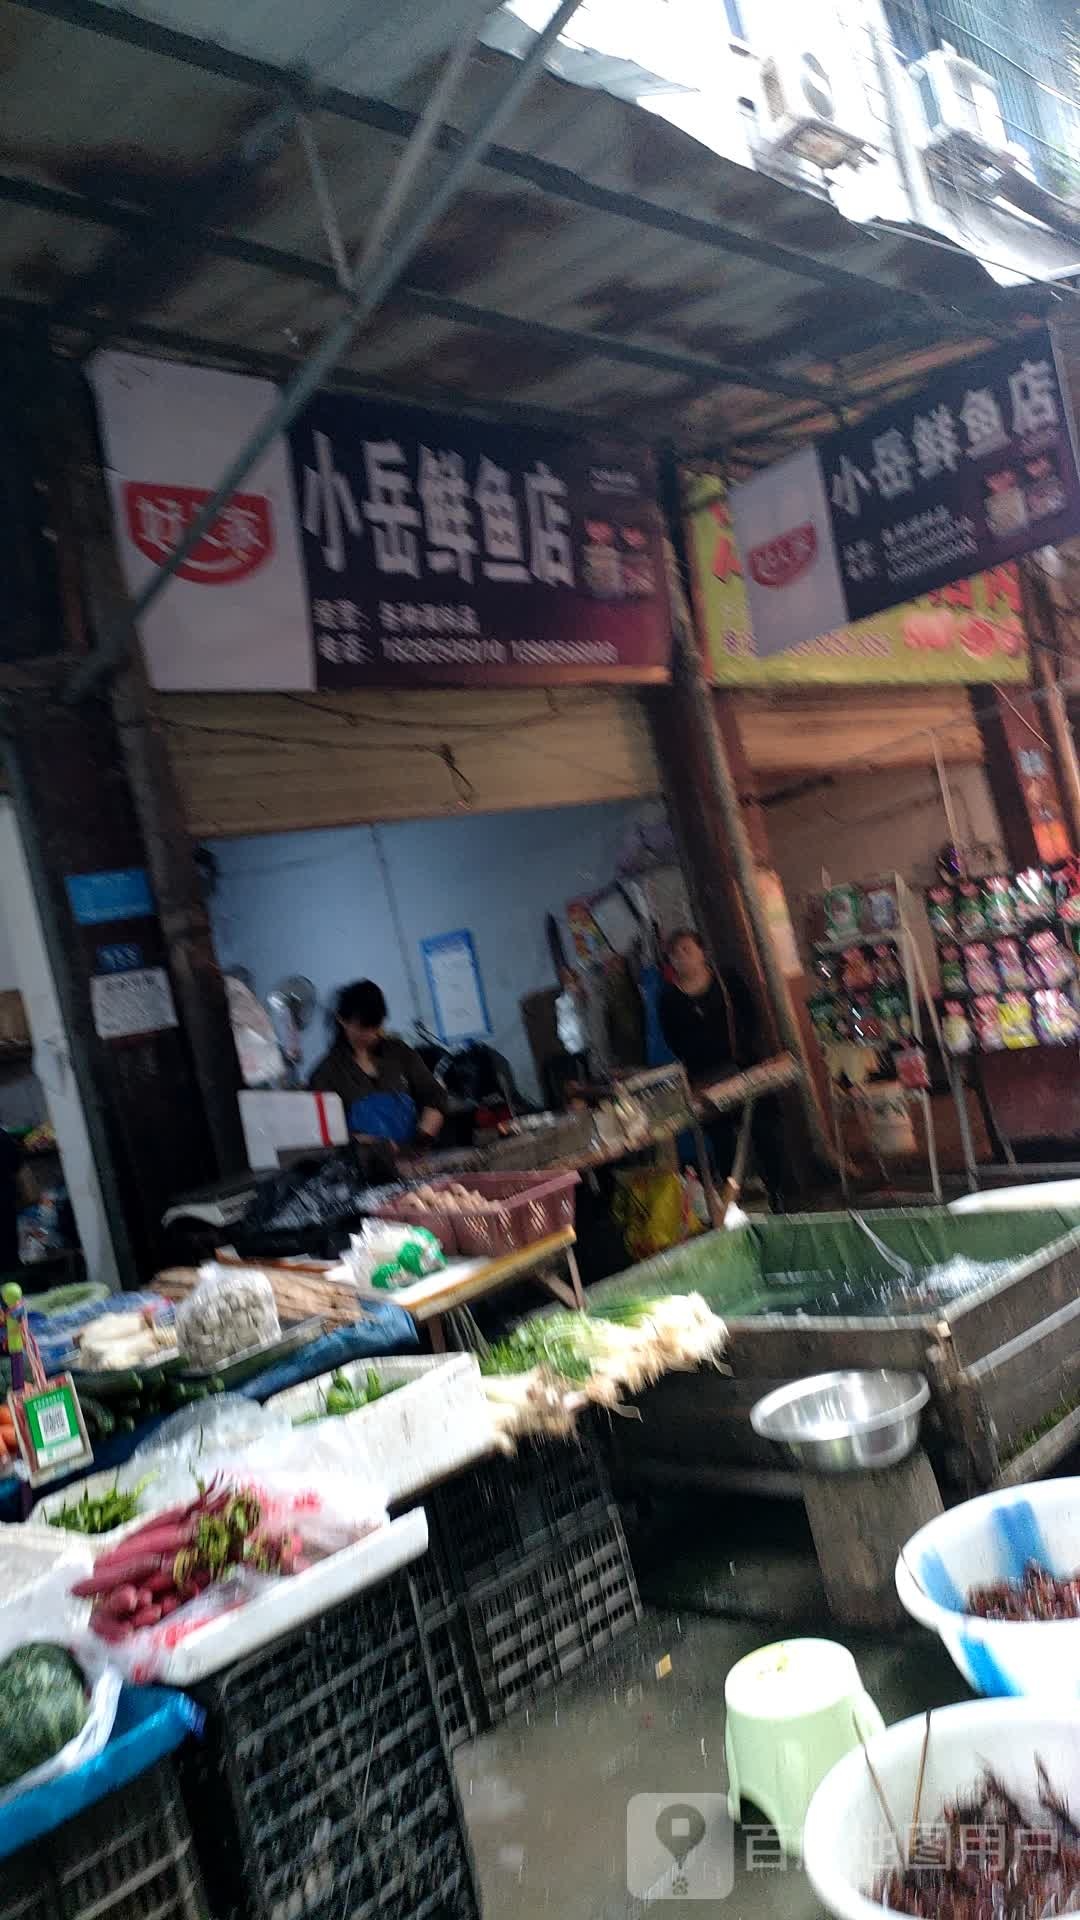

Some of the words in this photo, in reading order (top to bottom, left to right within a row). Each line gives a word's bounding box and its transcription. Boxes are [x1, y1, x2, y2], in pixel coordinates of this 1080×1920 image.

[303, 429, 577, 589] 小岳鲜鱼店
[832, 359, 1059, 516] 小岳鲜鱼店
